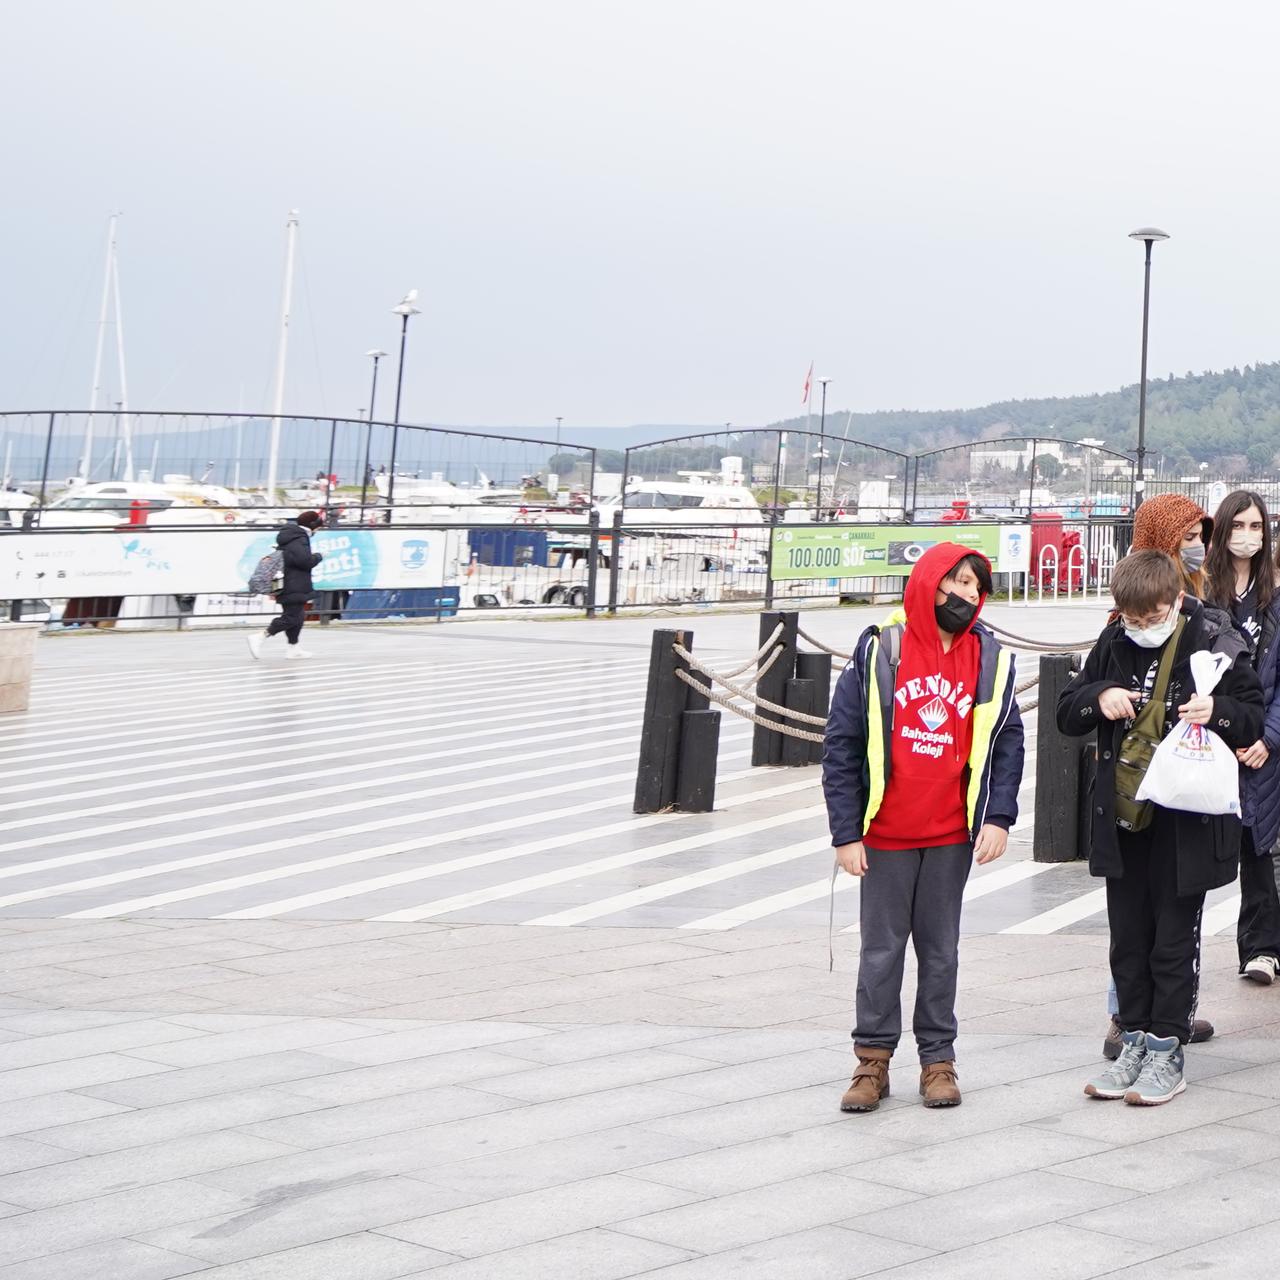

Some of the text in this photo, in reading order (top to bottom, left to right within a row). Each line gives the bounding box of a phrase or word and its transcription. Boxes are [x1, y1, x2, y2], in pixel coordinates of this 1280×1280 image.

[311, 548, 361, 576] enti
[789, 547, 840, 568] 100.000
[843, 542, 866, 567] SÖZ
[901, 726, 953, 744] Bahçeşehi
[912, 741, 943, 758] Koleji
